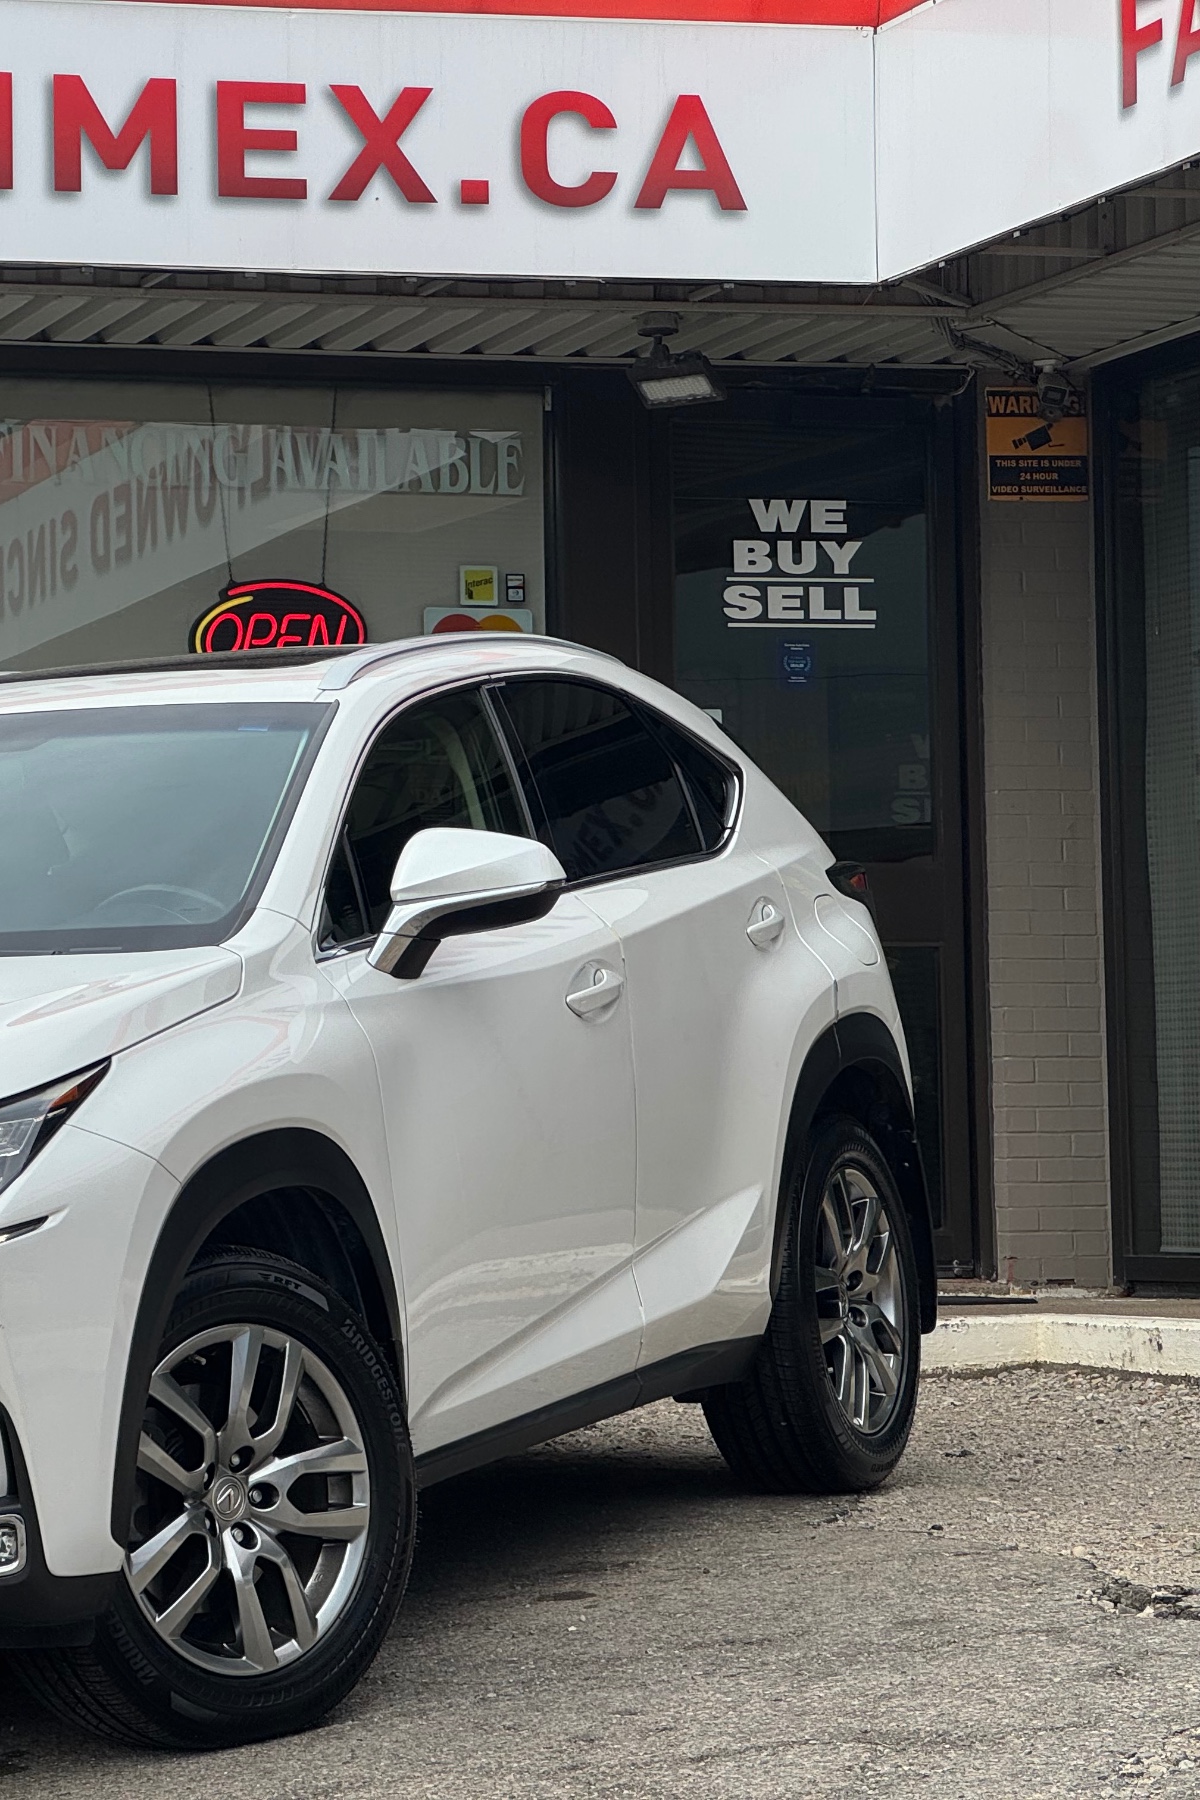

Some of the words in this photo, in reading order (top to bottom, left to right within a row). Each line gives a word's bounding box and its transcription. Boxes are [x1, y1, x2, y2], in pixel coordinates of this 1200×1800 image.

[269, 426, 525, 496] AVAILABLE
[996, 459, 1016, 467] THIS
[1019, 459, 1038, 467] SITE
[1041, 459, 1049, 467] IS
[1052, 459, 1082, 467] UNDER
[1020, 472, 1031, 480] 24
[1033, 472, 1059, 480] HOUR
[992, 485, 1018, 493] VIDEO
[1020, 485, 1087, 493] SURVEILLANCE
[748, 499, 848, 533] WE
[733, 540, 863, 574] BUY
[723, 585, 877, 620] SELL
[205, 613, 347, 651] OPEN
